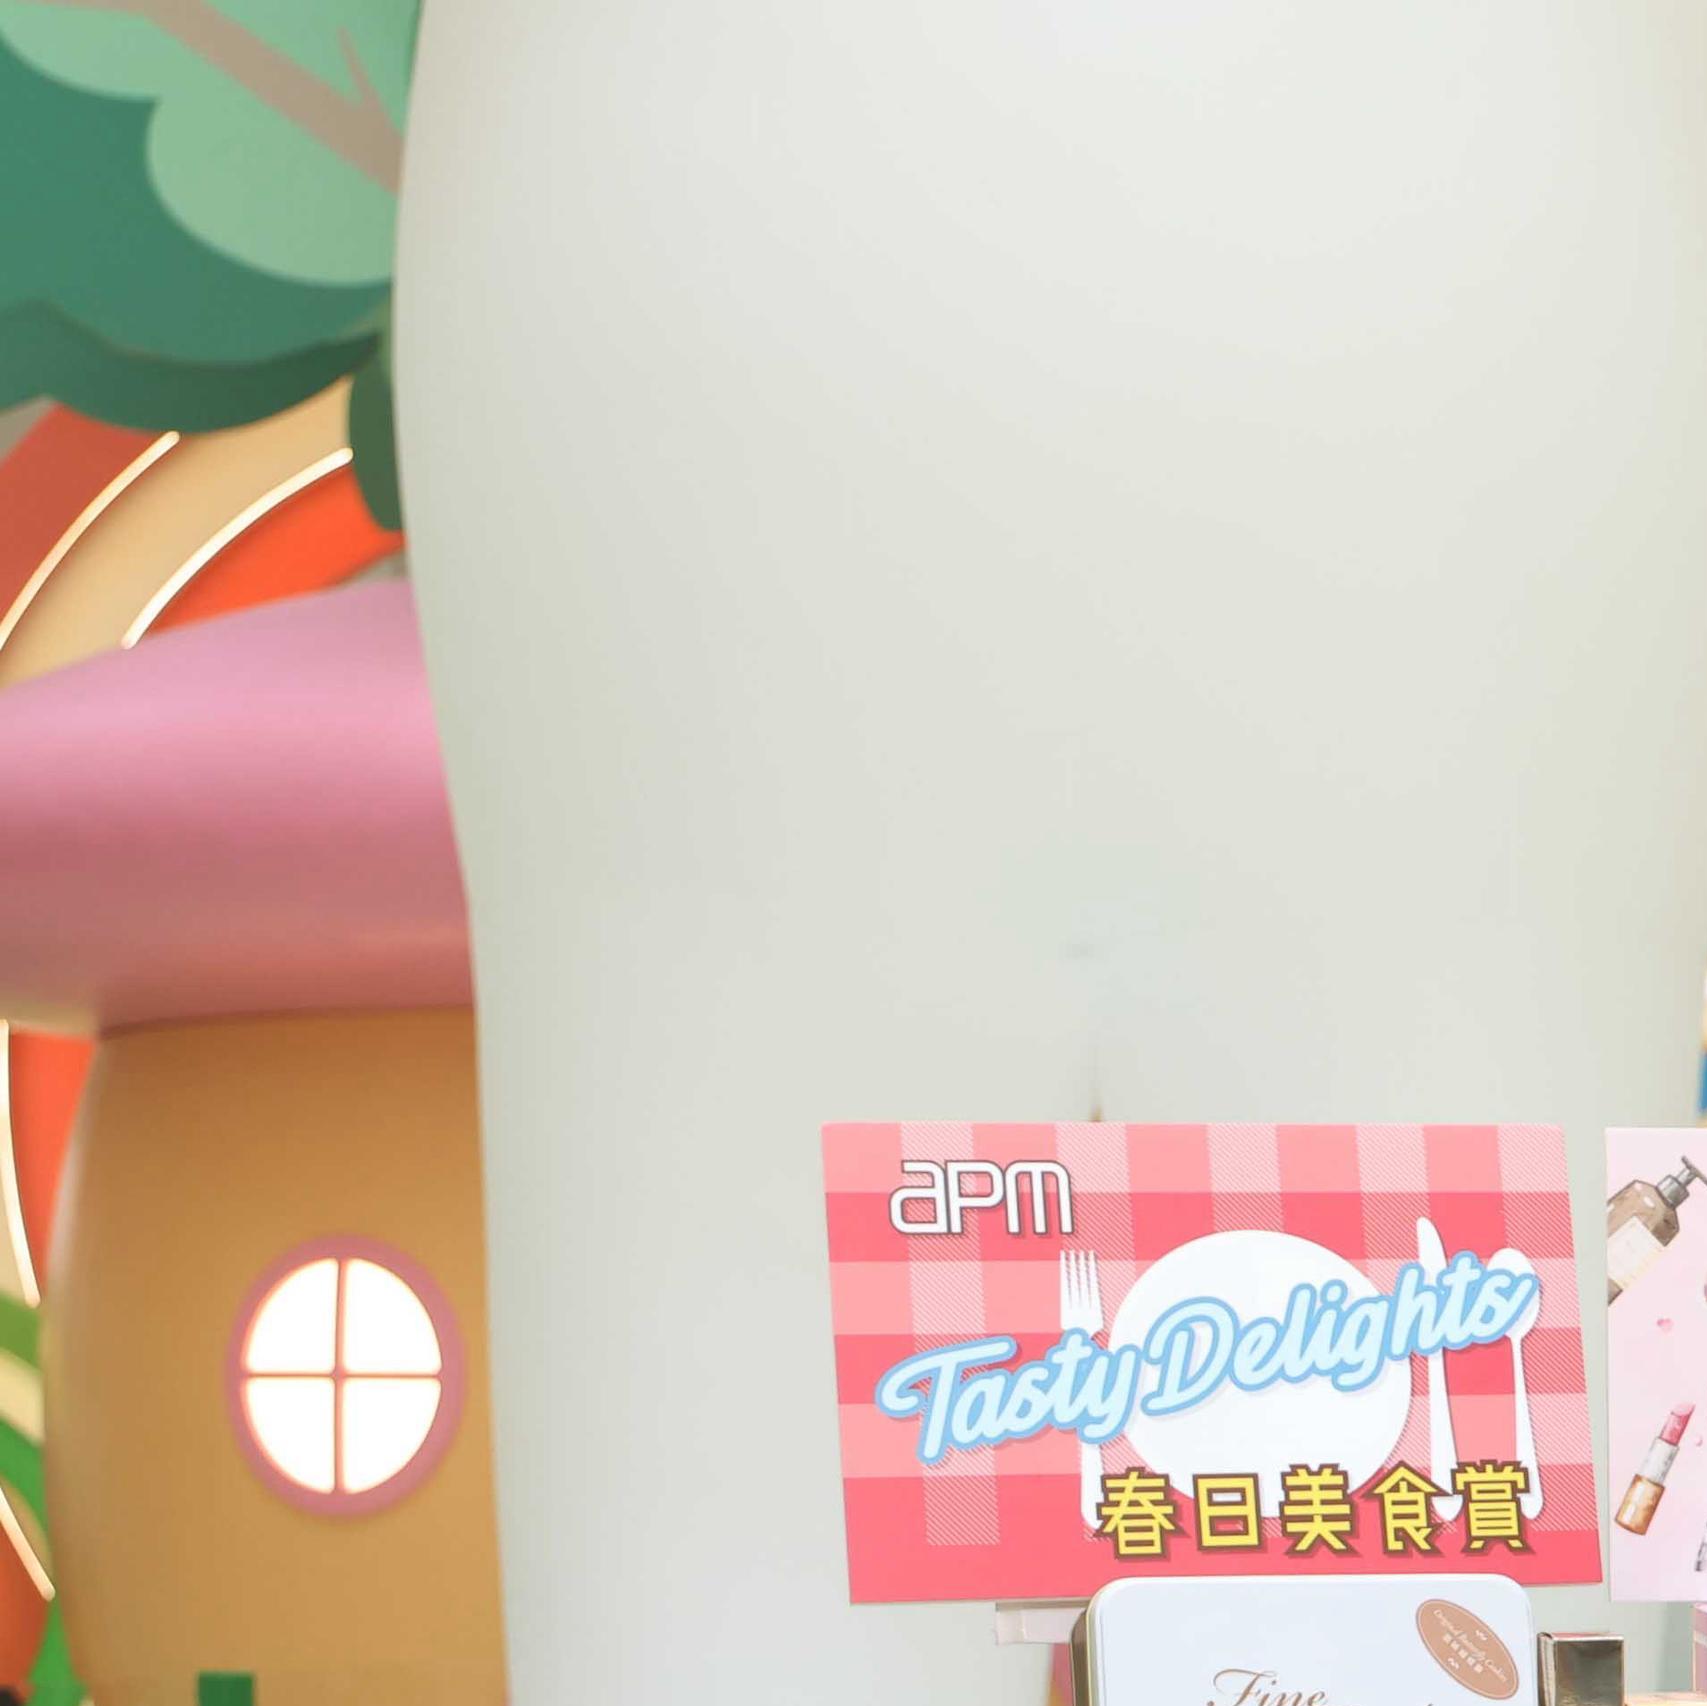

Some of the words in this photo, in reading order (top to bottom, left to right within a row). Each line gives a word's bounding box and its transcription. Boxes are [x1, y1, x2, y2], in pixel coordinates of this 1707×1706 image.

[889, 1159, 1075, 1236] apm
[876, 1326, 1144, 1465] Tasty
[1140, 1250, 1541, 1418] Delights
[1096, 1461, 1533, 1558] 春日美食賞
